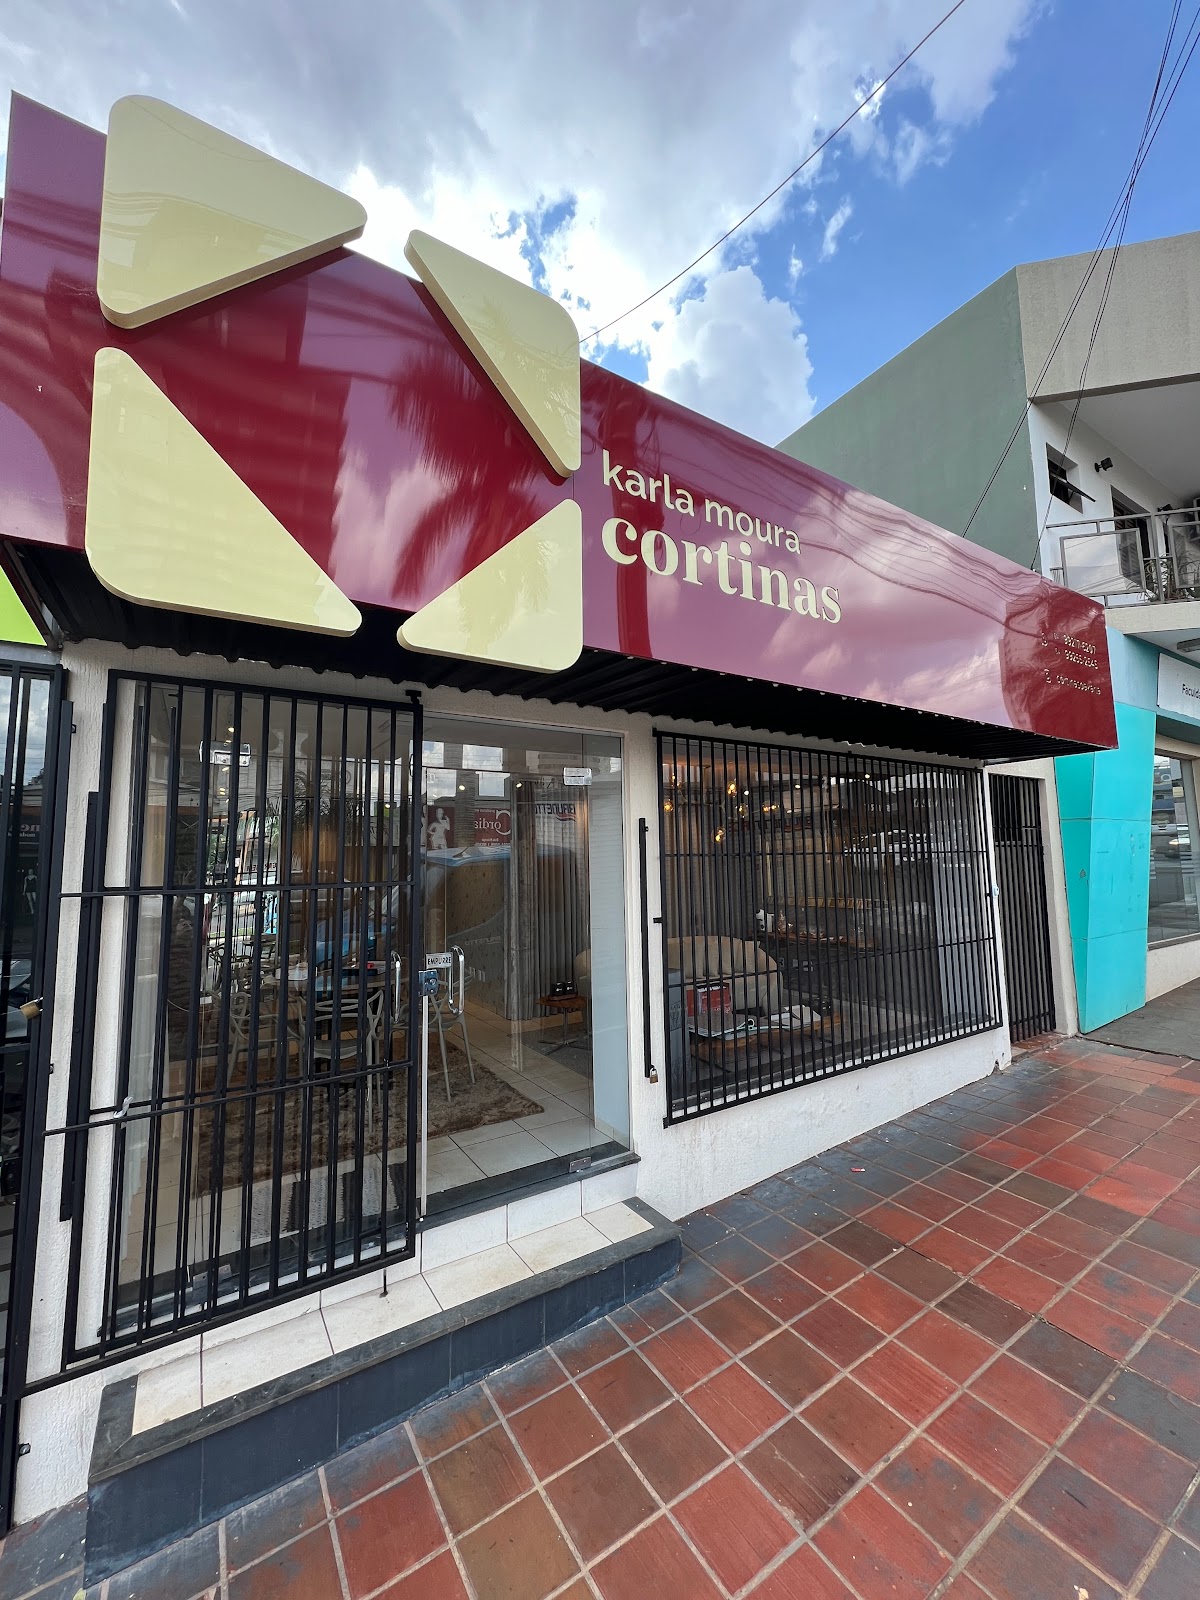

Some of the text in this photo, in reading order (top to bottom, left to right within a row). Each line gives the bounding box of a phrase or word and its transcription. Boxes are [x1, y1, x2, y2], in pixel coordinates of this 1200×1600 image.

[603, 449, 801, 554] karla moura
[602, 517, 842, 624] cortinas
[427, 956, 452, 966] EMPURRE
